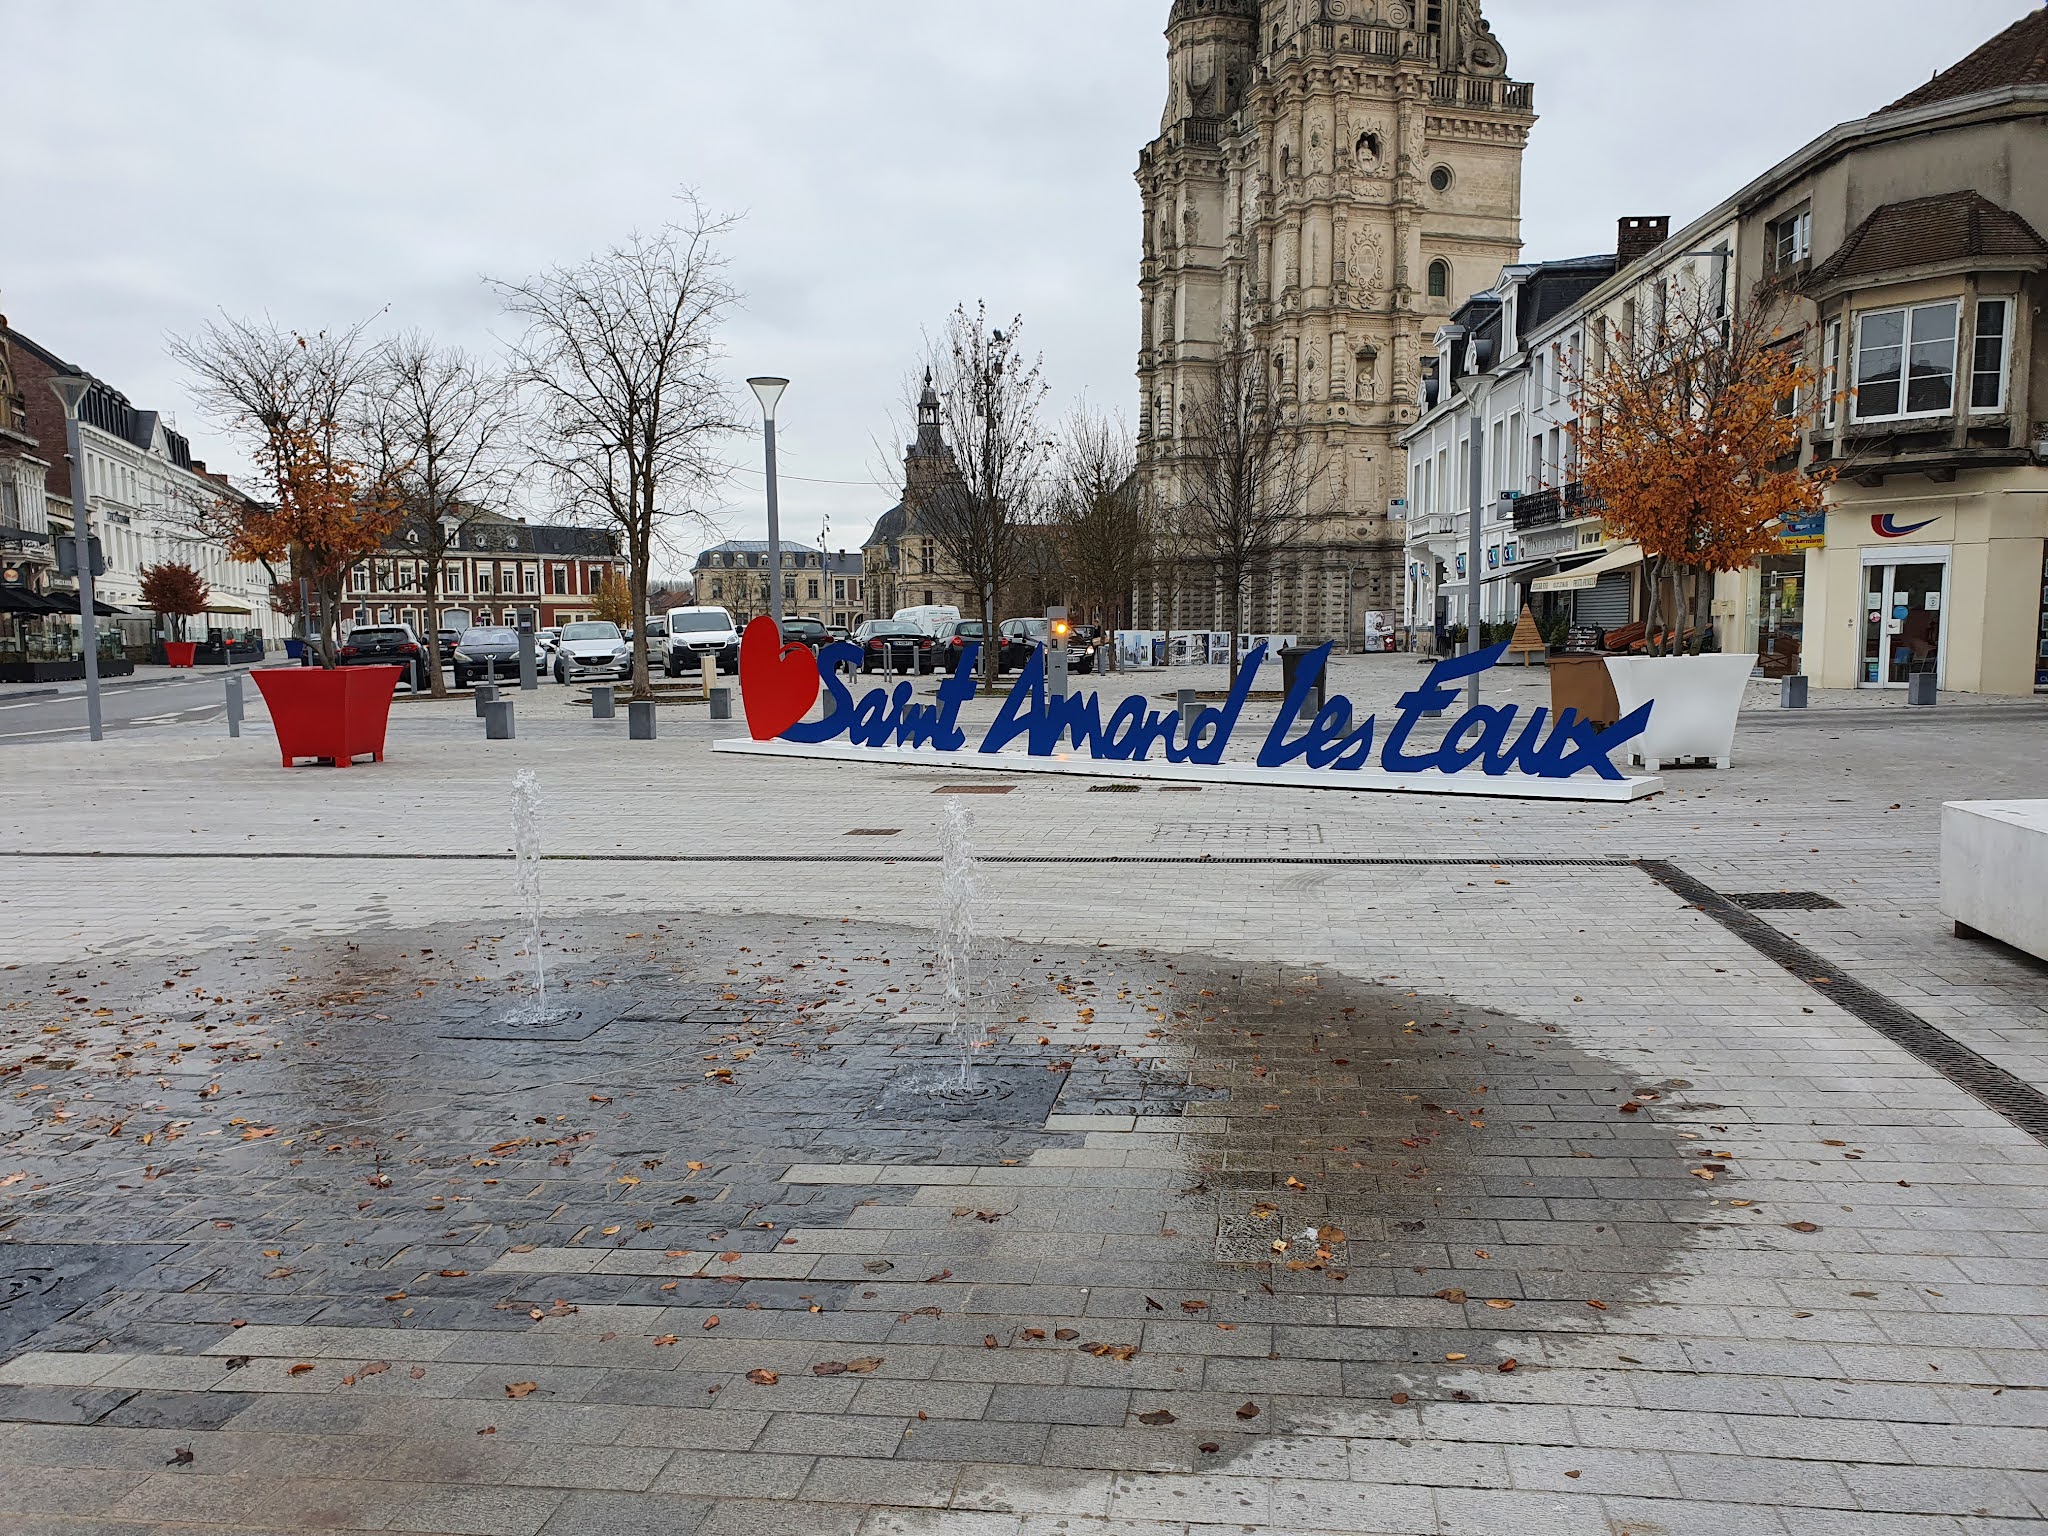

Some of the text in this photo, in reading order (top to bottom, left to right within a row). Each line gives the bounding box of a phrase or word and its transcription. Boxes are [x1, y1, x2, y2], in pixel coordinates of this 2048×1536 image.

[777, 642, 979, 751] Saint
[978, 641, 1268, 765] Amand
[1381, 640, 1655, 780] Eaux
